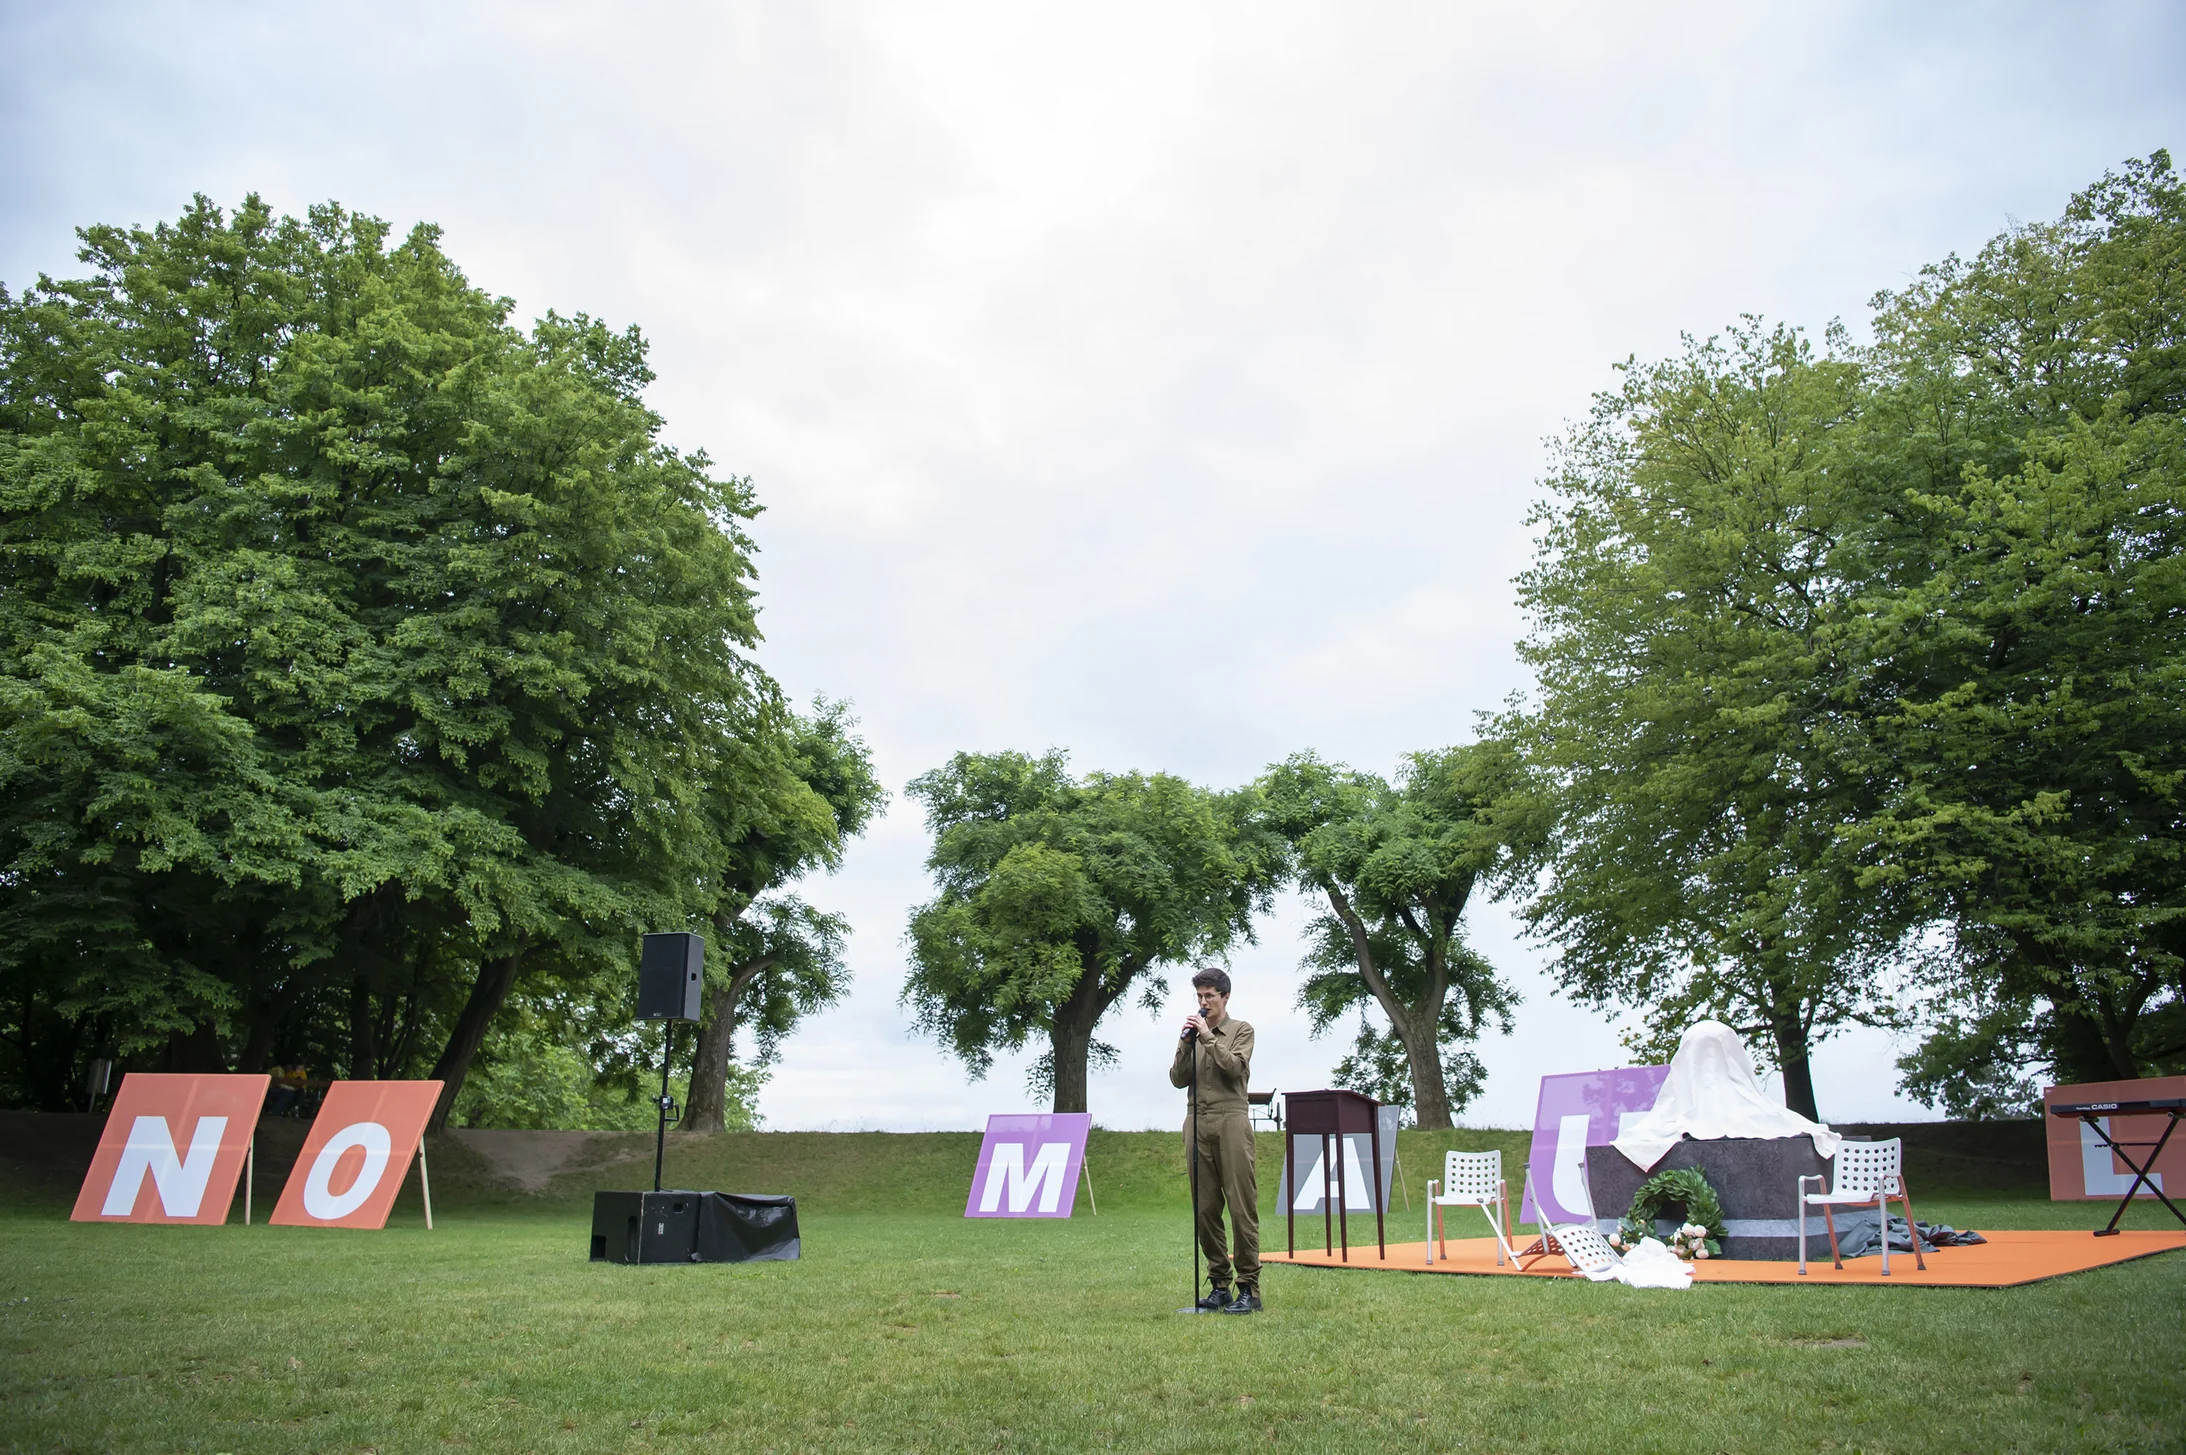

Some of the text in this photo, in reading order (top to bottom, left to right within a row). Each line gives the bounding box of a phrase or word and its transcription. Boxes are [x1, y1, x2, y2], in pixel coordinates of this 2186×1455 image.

[101, 1116, 229, 1217] N
[303, 1122, 391, 1220] O
[979, 1143, 1071, 1212] M
[1291, 1137, 1371, 1209] A
